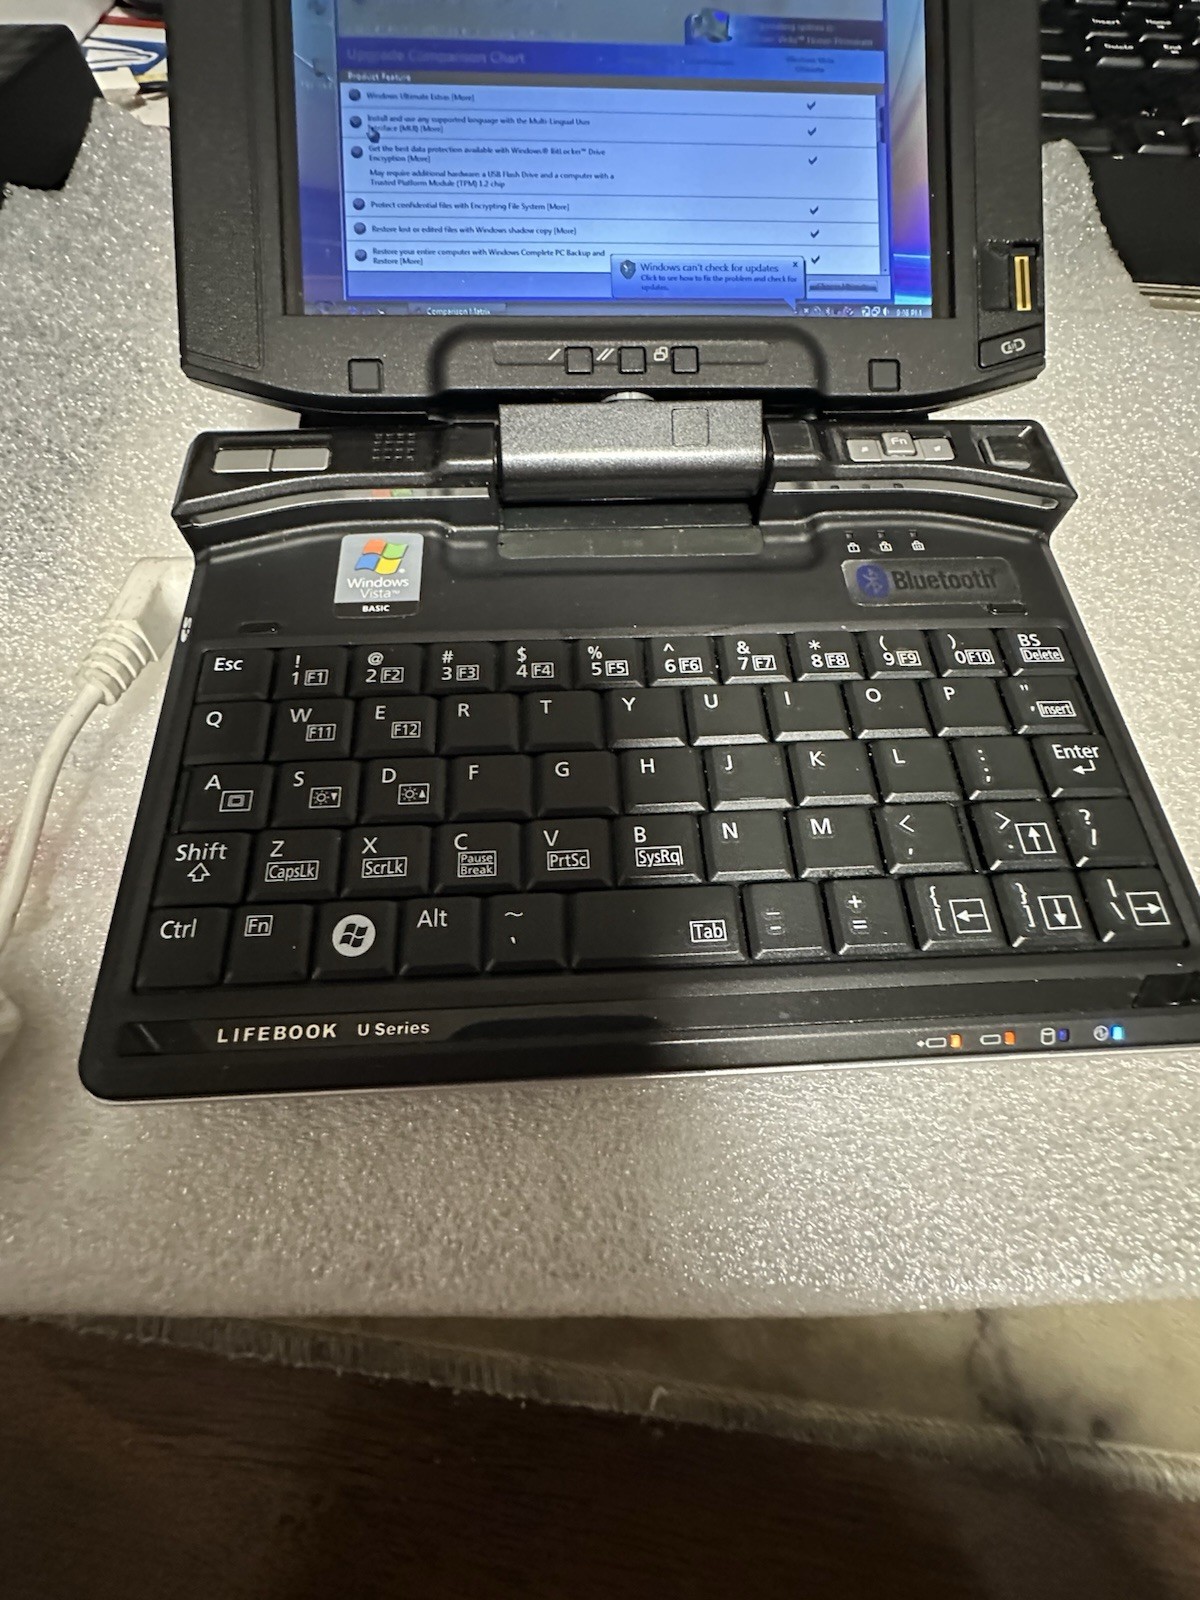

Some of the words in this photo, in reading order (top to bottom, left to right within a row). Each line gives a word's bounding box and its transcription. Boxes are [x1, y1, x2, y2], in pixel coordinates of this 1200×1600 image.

[491, 51, 525, 64] Chart
[366, 92, 398, 101] Windows
[427, 146, 463, 155] protection
[495, 147, 510, 155] with
[588, 148, 606, 156] Drive
[369, 169, 385, 178] May
[412, 170, 446, 178] additional
[521, 171, 539, 179] Drive
[594, 172, 609, 180] with
[370, 179, 396, 187] Trusted
[397, 179, 427, 187] Platform
[429, 179, 455, 187] Module
[490, 180, 506, 189] chip
[370, 201, 396, 209] Protect
[397, 201, 438, 210] confidential
[454, 202, 469, 210] with
[470, 202, 507, 212] Encrypting
[521, 203, 546, 212] System
[546, 203, 570, 212] [More]
[371, 225, 397, 233] Restore
[421, 226, 443, 234] edited
[459, 226, 474, 234] with
[508, 226, 535, 235] shadow
[535, 228, 552, 236] copy
[553, 227, 577, 236] [More]
[372, 247, 398, 256] Restore
[472, 248, 488, 256] with
[488, 249, 520, 257] Windows
[520, 249, 553, 258] Complete
[566, 249, 591, 258] Backup
[373, 257, 399, 265] Restore
[399, 257, 424, 266] [More]
[640, 262, 681, 272] Windows
[682, 262, 703, 272] can't
[704, 262, 729, 272] check
[731, 263, 743, 272] for
[745, 263, 779, 274] updates
[640, 274, 657, 282] Click
[679, 274, 694, 282] how
[724, 275, 752, 284] problem
[753, 275, 766, 283] and
[767, 275, 786, 283] check
[891, 437, 908, 446] Fn
[346, 577, 410, 589] Windows
[890, 567, 998, 591] Bluetooth
[362, 604, 391, 613] BASIC
[1017, 633, 1041, 647] BS
[826, 654, 847, 667] F8
[899, 652, 919, 665] F9
[968, 651, 992, 664] F10
[1024, 649, 1063, 661] Delete
[213, 657, 244, 672] Esc
[533, 664, 552, 676] F4
[607, 662, 627, 674] F5
[680, 659, 700, 672] F6
[754, 657, 773, 669] F7
[382, 669, 402, 681] F2
[458, 667, 478, 679] F3
[703, 693, 718, 709] U
[784, 690, 792, 706] I
[865, 688, 882, 703] O
[943, 686, 956, 701] P
[457, 703, 471, 718] R
[539, 699, 552, 714] T
[621, 696, 636, 712] Y
[1039, 702, 1074, 716] Insert
[206, 711, 223, 728] Q
[290, 708, 313, 723] W
[375, 705, 387, 720] E
[307, 726, 332, 739] F11
[392, 723, 419, 736] F12
[809, 750, 826, 767] K
[891, 748, 906, 764] L
[1052, 743, 1100, 760] Enter
[554, 761, 570, 778] G
[640, 758, 656, 774] H
[724, 754, 733, 771] J
[293, 771, 305, 787] S
[381, 768, 397, 784] D
[468, 764, 480, 781] F
[204, 774, 222, 791] A
[721, 821, 739, 840] N
[809, 817, 833, 836] M
[454, 833, 469, 850] C
[543, 829, 560, 847] V
[633, 826, 648, 843] B
[175, 841, 229, 861] Shift
[269, 840, 285, 858] Z
[361, 836, 379, 854] X
[459, 853, 495, 864] Pause
[549, 852, 588, 868] PrtSc
[637, 849, 682, 867] SysRq
[268, 863, 316, 881] CapsLk
[364, 859, 405, 876] ScrLk
[459, 864, 494, 876] Break
[416, 907, 449, 929] Alt
[159, 918, 198, 939] Ctrl
[246, 918, 270, 935] Fn
[692, 923, 724, 940] Tab
[216, 1022, 338, 1044] LIFEBOOK
[357, 1022, 371, 1038] U
[374, 1021, 431, 1036] Series
